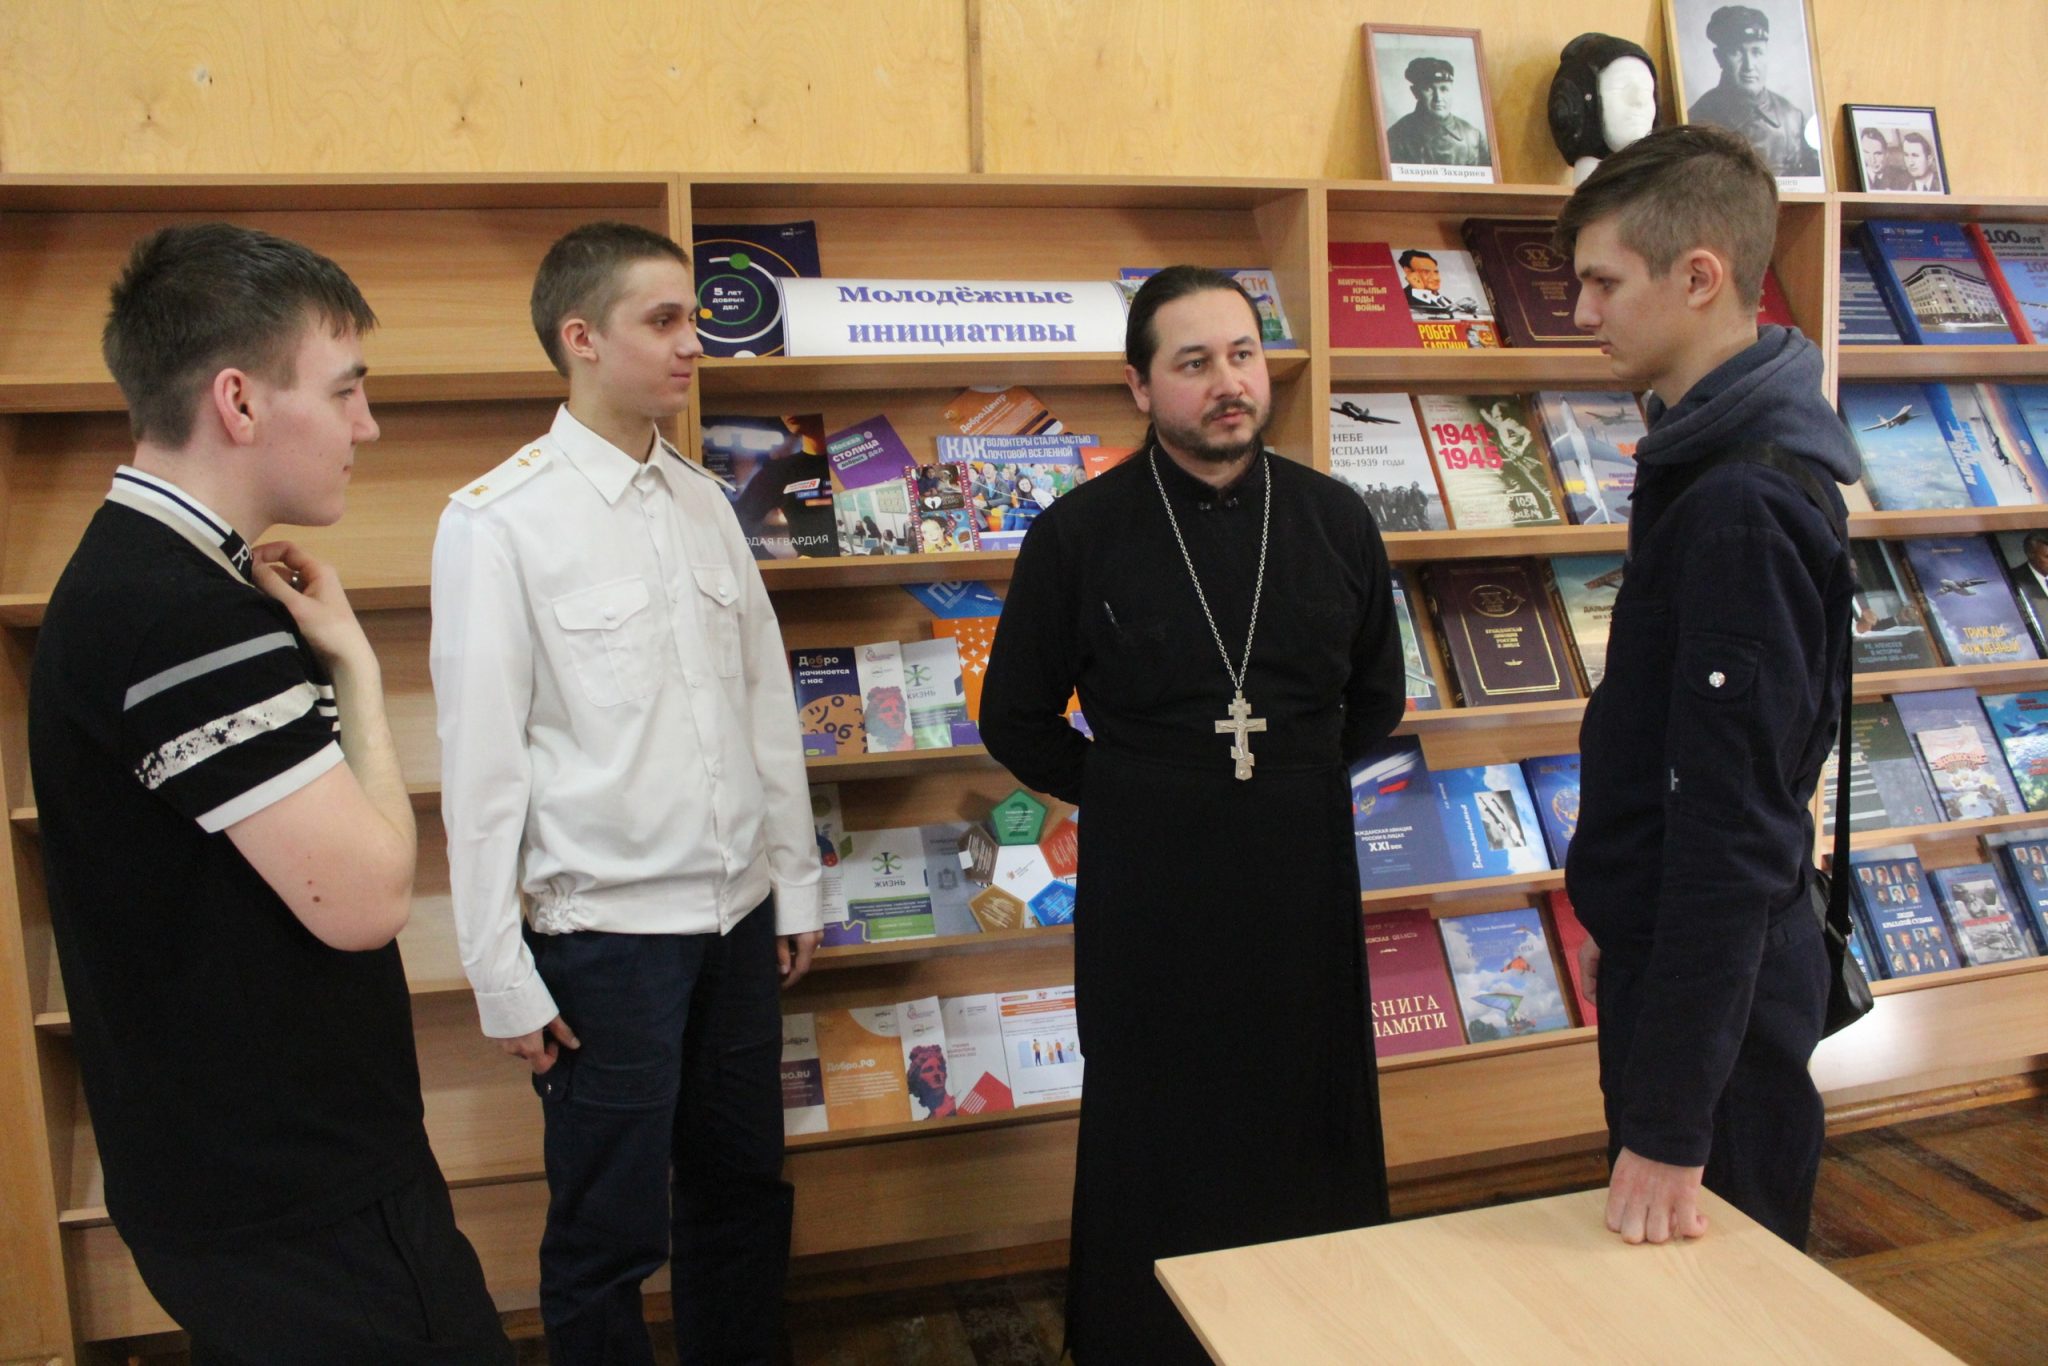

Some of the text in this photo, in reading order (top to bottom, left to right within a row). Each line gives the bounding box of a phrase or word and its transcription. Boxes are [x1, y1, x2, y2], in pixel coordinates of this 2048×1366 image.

[1397, 166, 1485, 177] Захарий Захариев
[1984, 229, 2021, 243] 100
[1337, 278, 1374, 286] МИРНЫЕ
[713, 287, 723, 296] 5
[837, 286, 1074, 305] Молодёжные
[1355, 304, 1385, 312] ВОЙНЫ
[848, 323, 1077, 347] инициативы
[1417, 324, 1457, 340] РОБЕРТ
[1332, 433, 1364, 442] НЕБЕ
[1431, 423, 1495, 446] 1941-
[945, 435, 1091, 459] КАК ВОЛОНТЕРЫ СТАЛИ ЧАСТЬЮ
[988, 447, 1073, 459] ПОЧТОВОЙ ВСЕЛЕННОЙ
[1439, 447, 1504, 470] 1945
[777, 534, 829, 546] ГВАРДИЯ
[799, 656, 839, 666] Добро
[874, 879, 906, 889] ЖИЗНЬ
